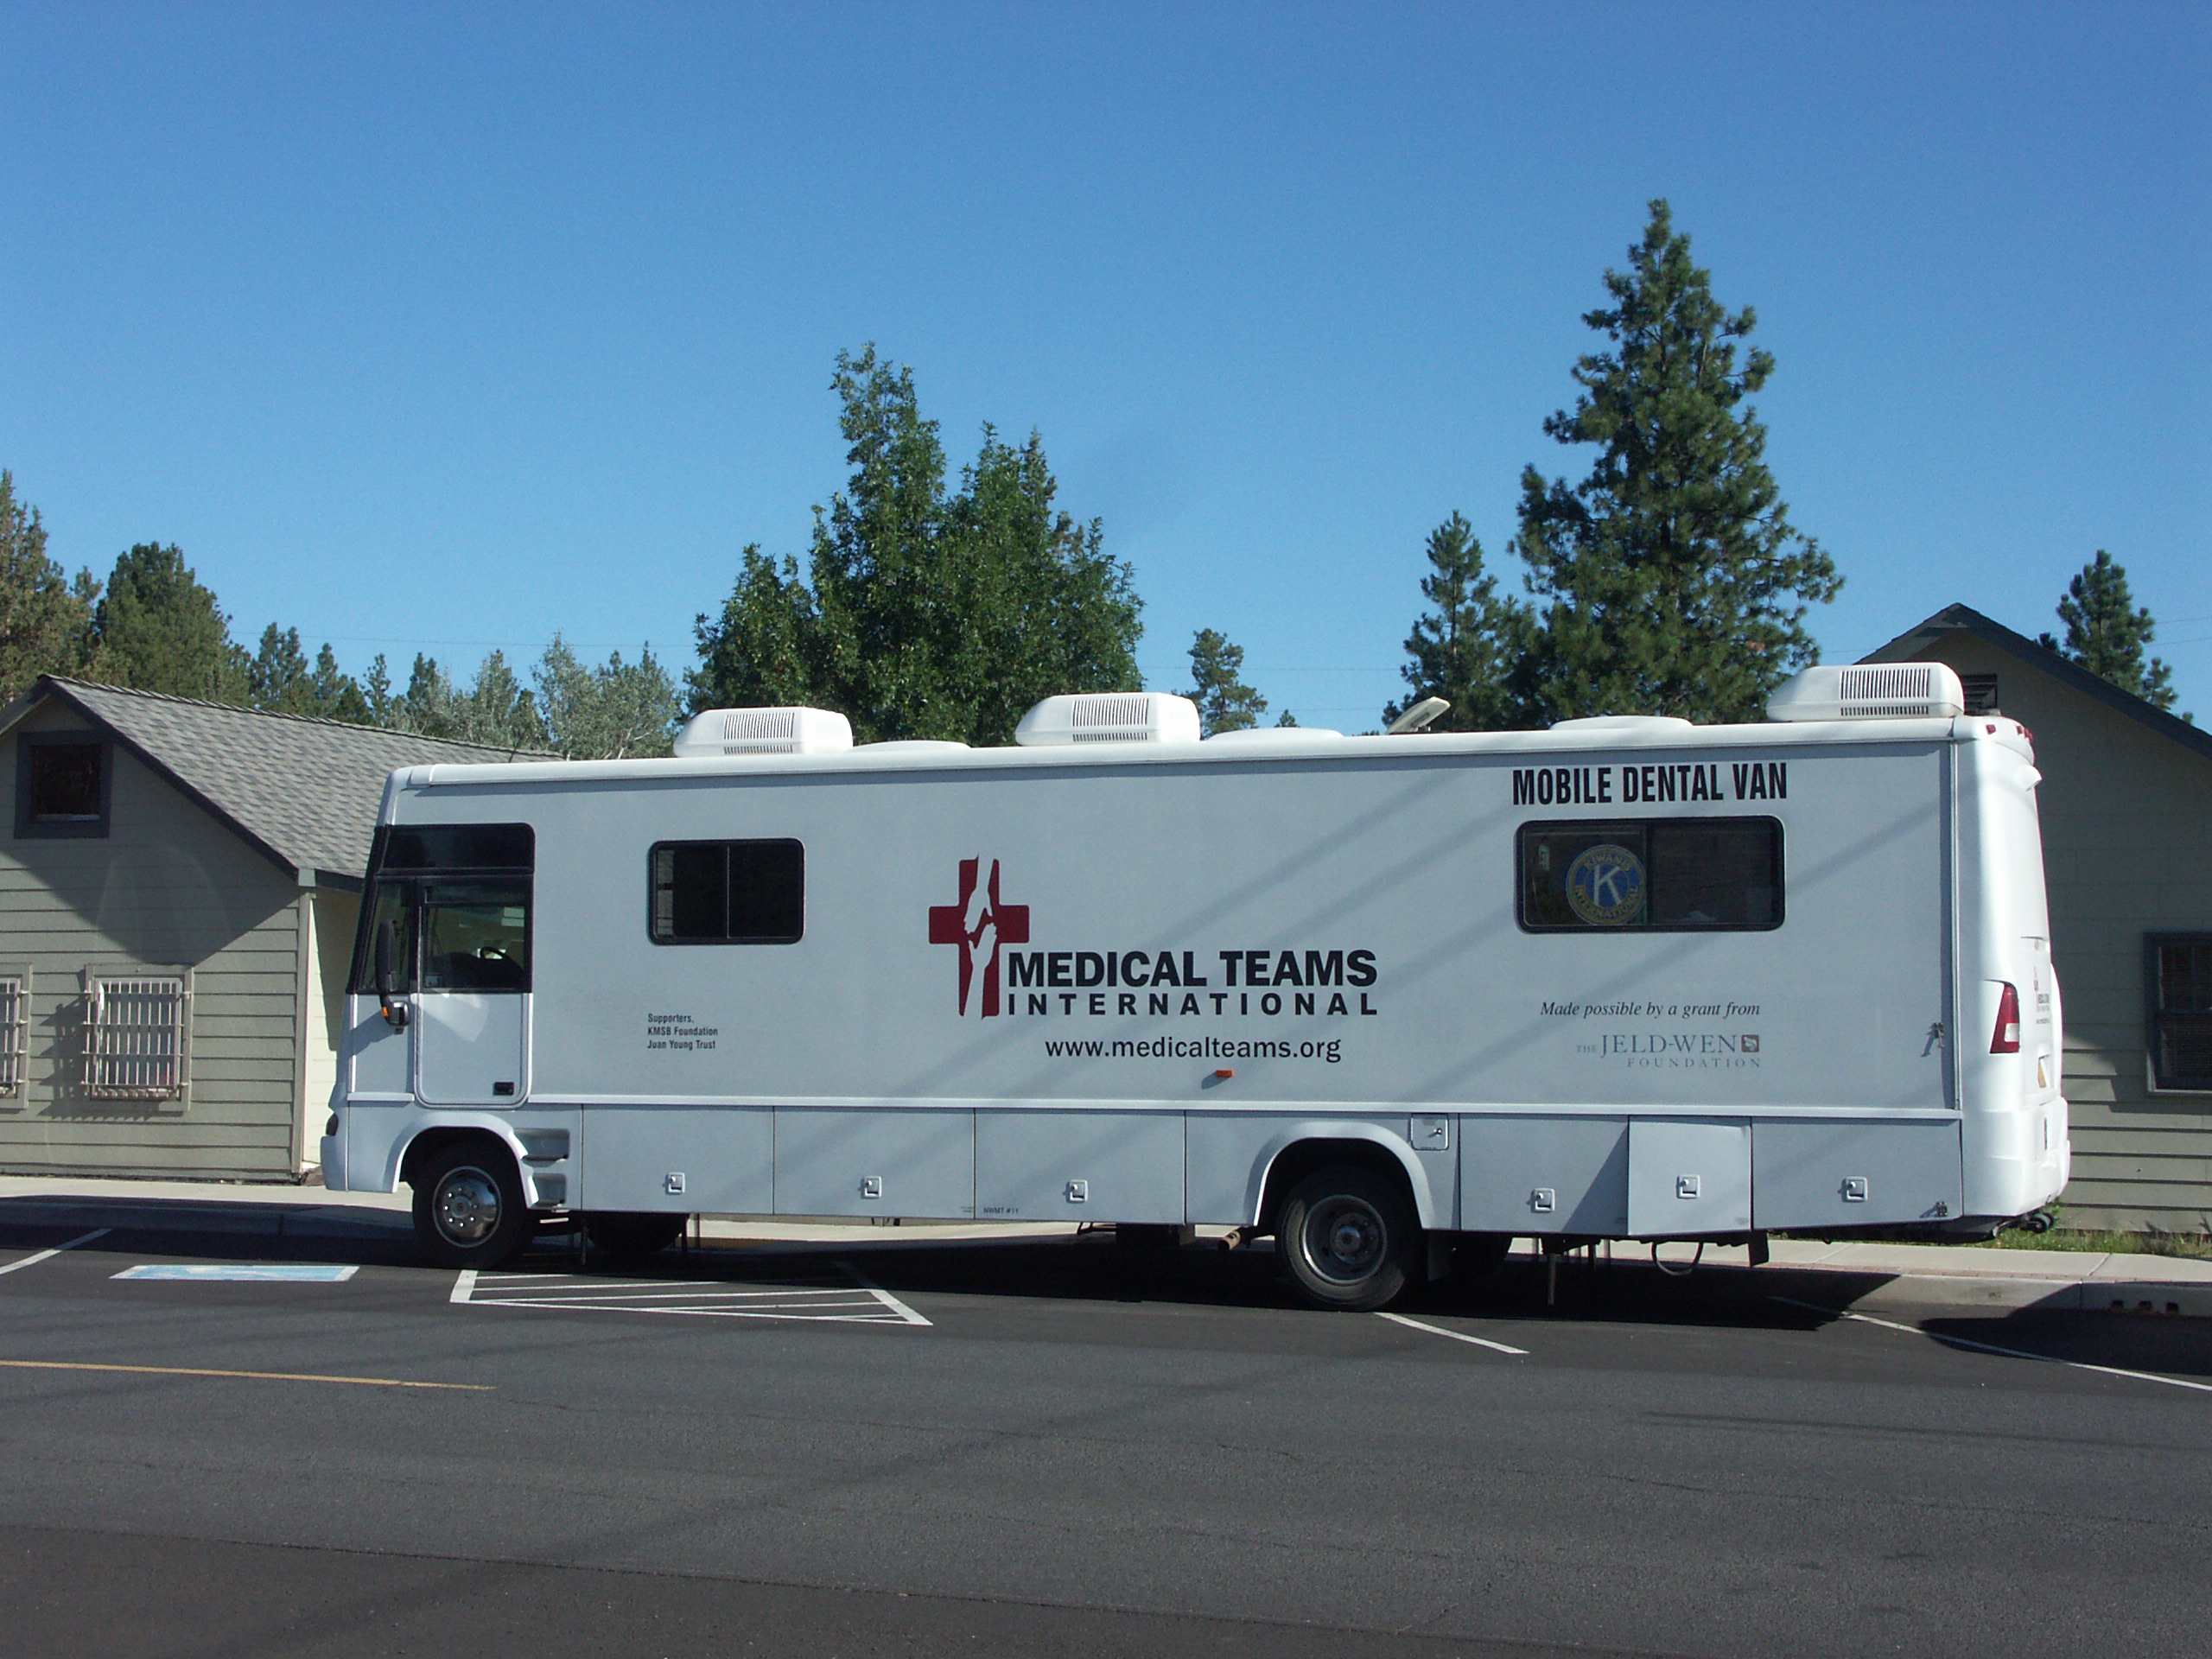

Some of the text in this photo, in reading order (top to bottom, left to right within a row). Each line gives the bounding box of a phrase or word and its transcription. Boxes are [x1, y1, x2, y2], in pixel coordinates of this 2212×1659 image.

[1512, 762, 1787, 805] MOBILE DENTAL VAN
[1593, 865, 1623, 906] K
[1008, 949, 1378, 988] MEDICAL TEAMS
[1008, 992, 1377, 1016] INTERNATIONAL
[1541, 1001, 1760, 1020] Made possible by a grant from
[647, 1027, 718, 1036] KMSB Foundation
[647, 1039, 716, 1051] Juan Young Trust
[1045, 1036, 1342, 1064] www.medicalteams.org
[1576, 1033, 1737, 1058] THE JELD-WEN
[1627, 1058, 1761, 1068] FOUNDATION
